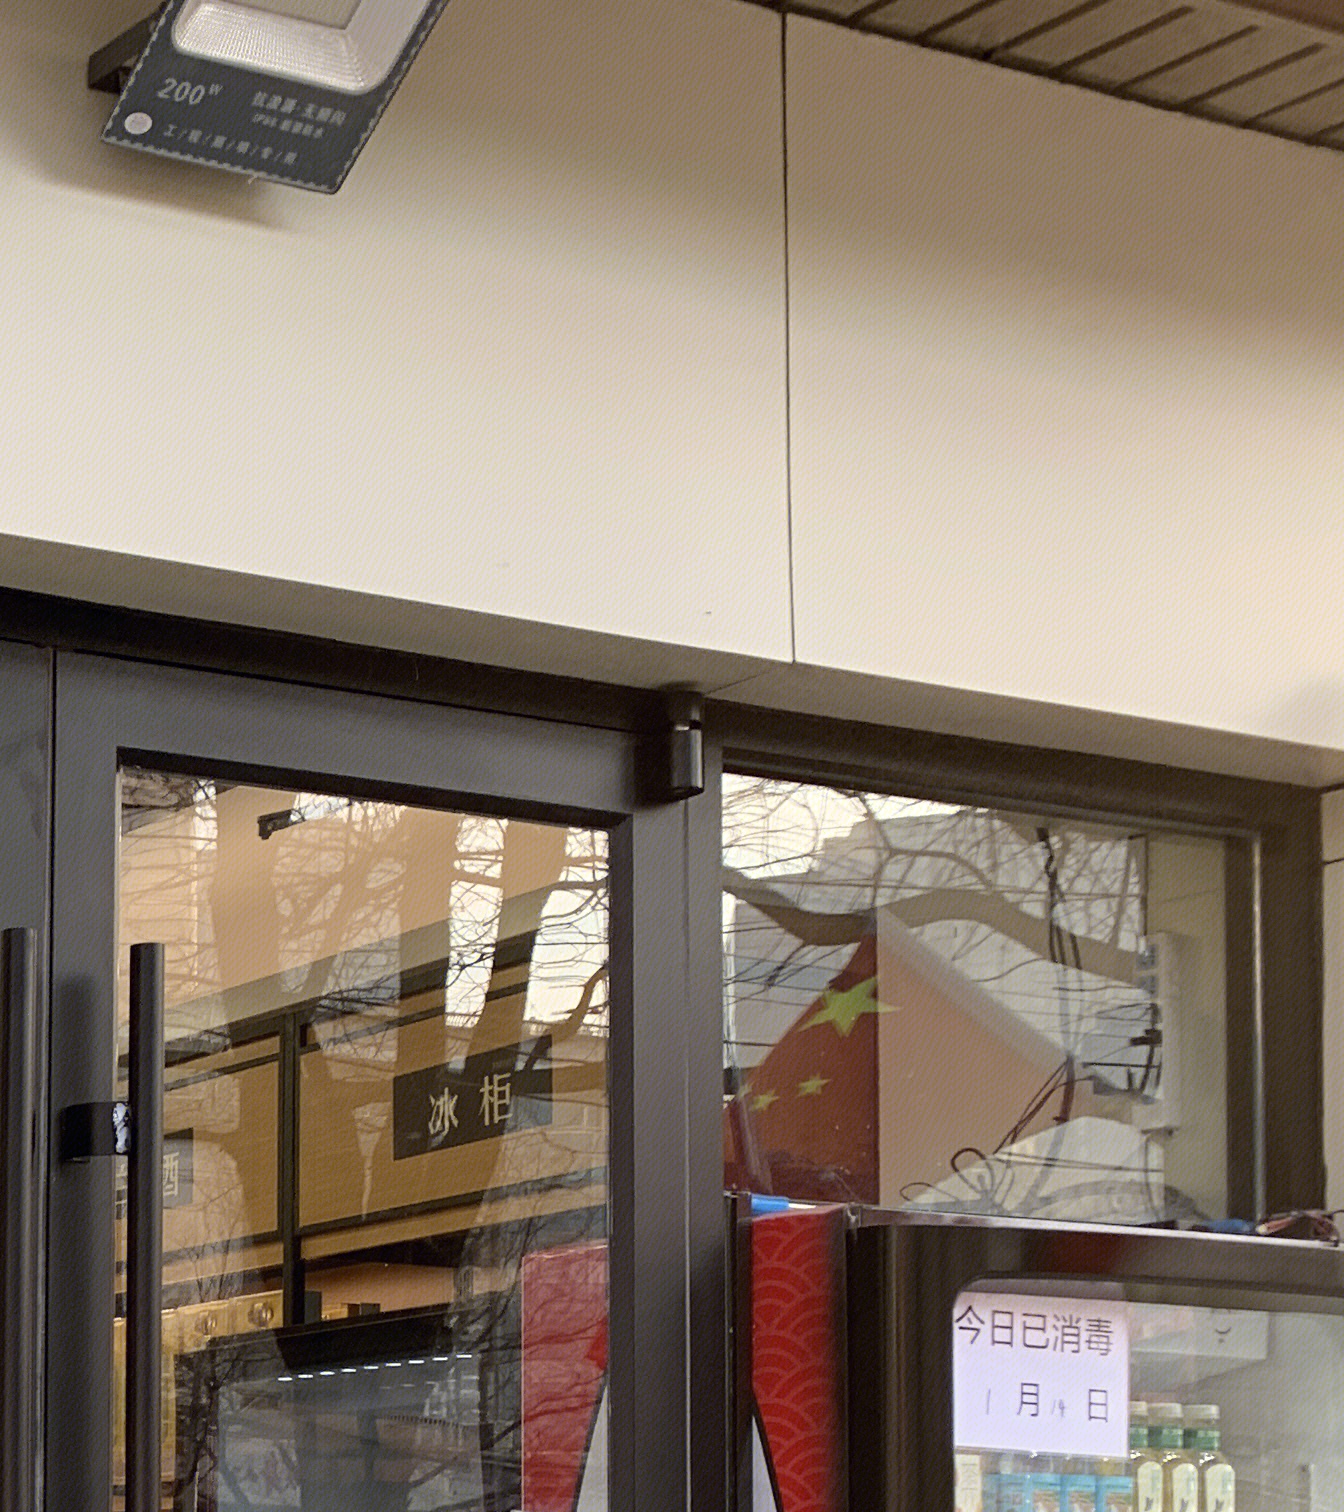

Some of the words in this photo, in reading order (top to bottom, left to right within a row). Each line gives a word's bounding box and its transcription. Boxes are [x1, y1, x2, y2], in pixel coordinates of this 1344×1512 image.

[429, 1071, 513, 1139] 冰柜
[954, 1304, 1114, 1356] 今日已消毒
